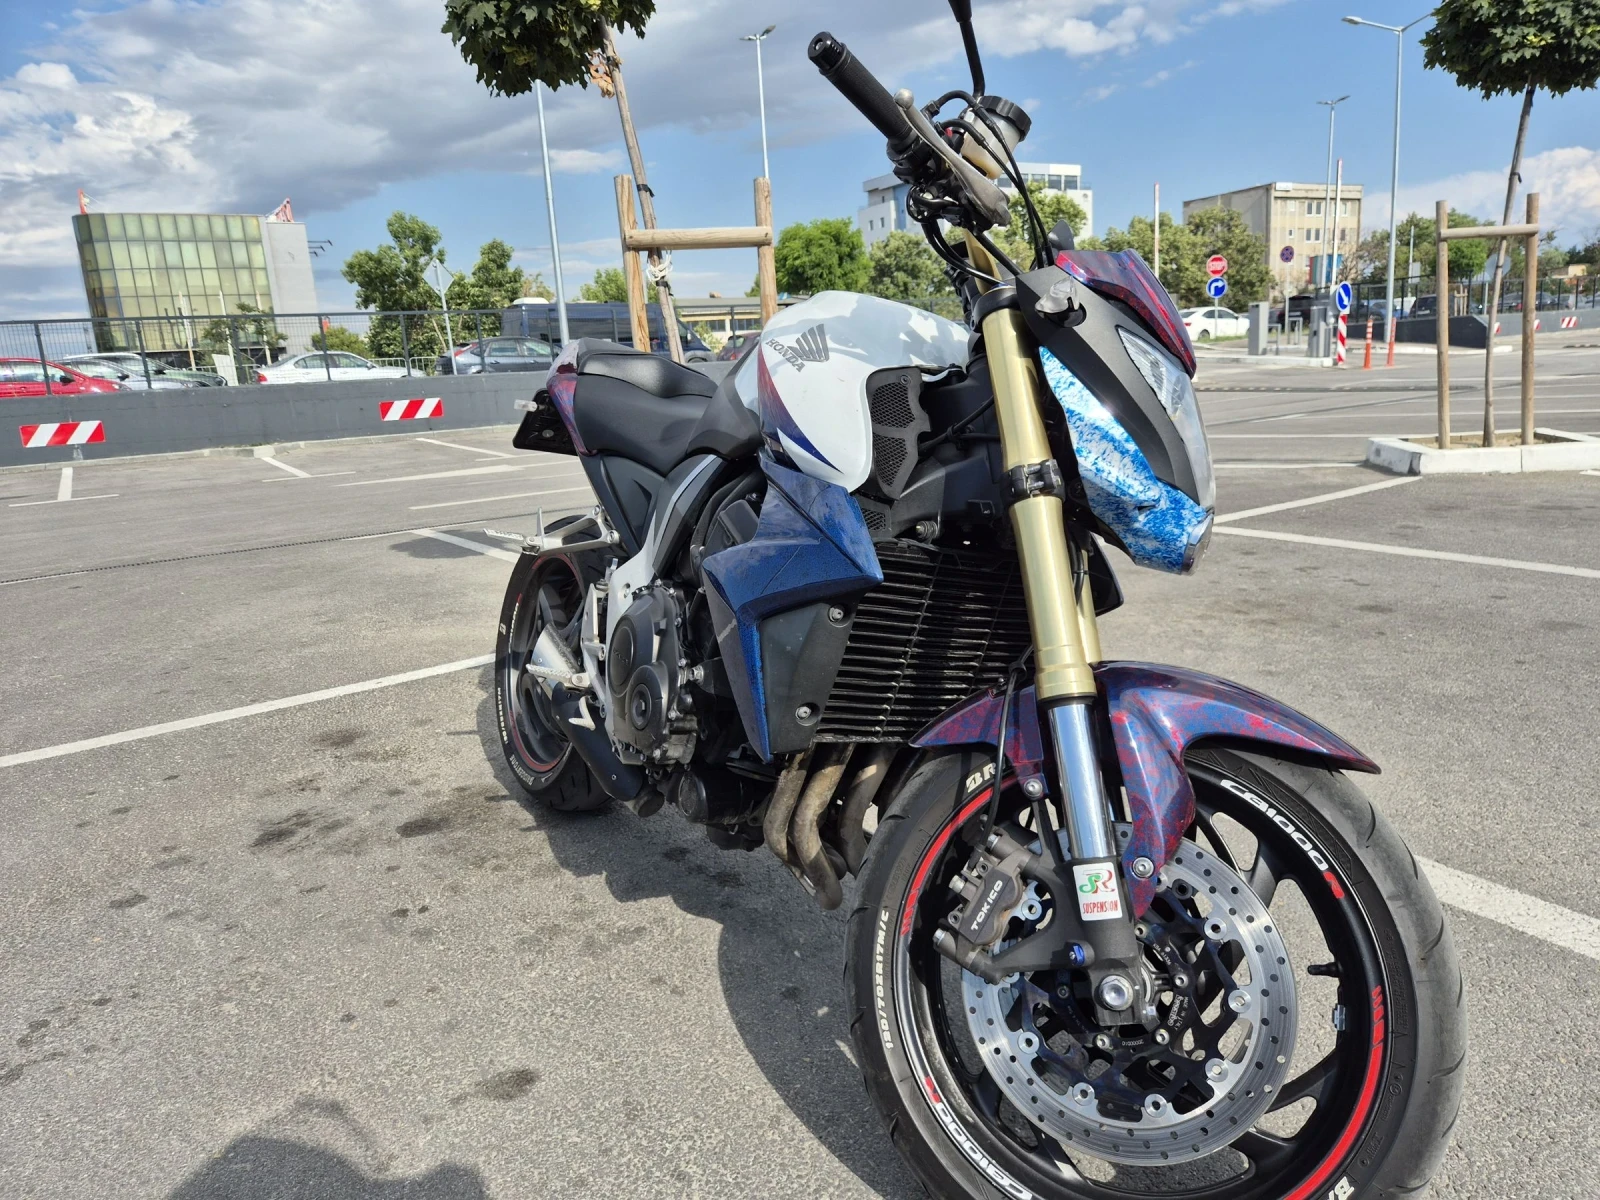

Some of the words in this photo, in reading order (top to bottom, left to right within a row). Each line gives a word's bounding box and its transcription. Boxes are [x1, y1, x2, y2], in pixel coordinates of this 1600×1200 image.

[765, 338, 806, 373] HONDA
[1220, 779, 1345, 899] CB1000R
[970, 880, 1003, 931] TOKICO
[1082, 900, 1119, 914] SUSPENSION
[924, 1075, 1033, 1200] CB1000R
